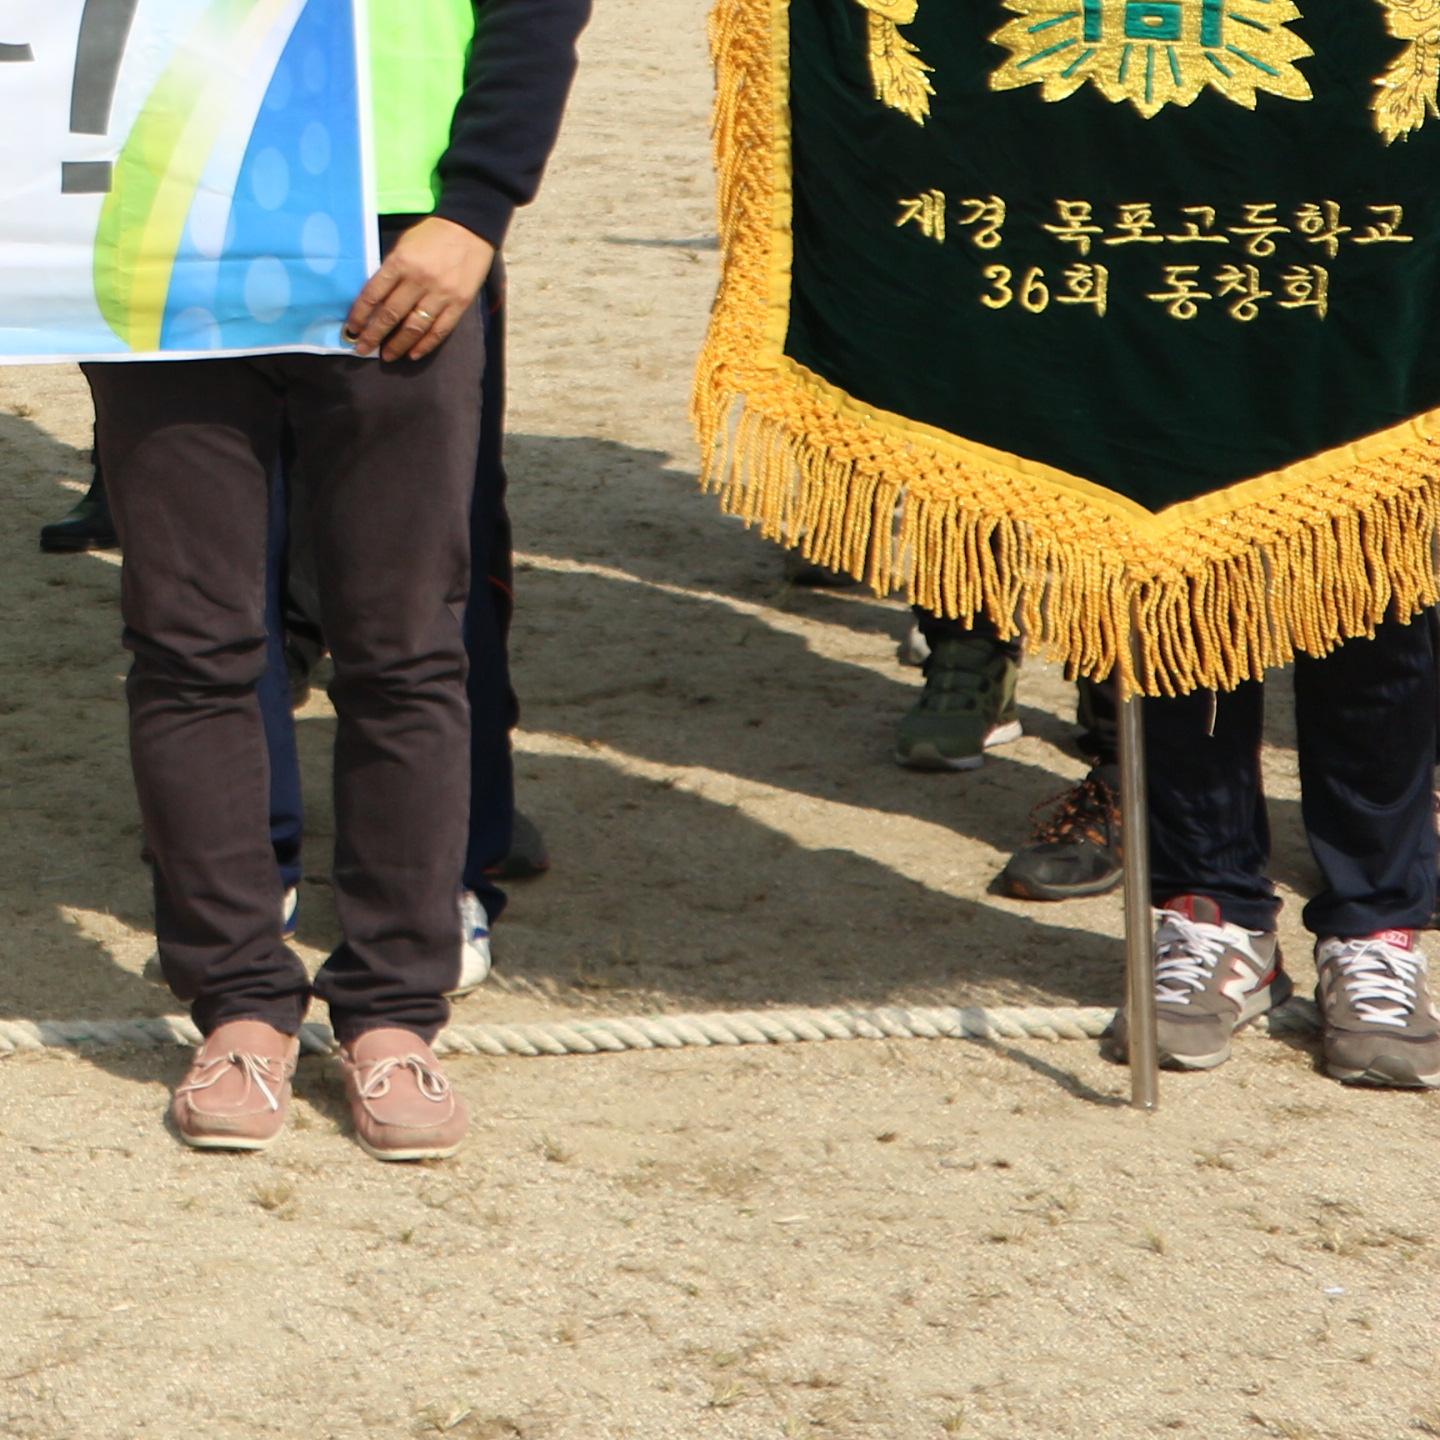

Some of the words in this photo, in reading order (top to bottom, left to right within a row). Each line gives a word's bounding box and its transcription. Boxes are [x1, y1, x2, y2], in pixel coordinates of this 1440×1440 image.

[896, 189, 1007, 250] 재경
[1041, 197, 1414, 260] 목포고등학교
[981, 262, 1110, 320] 36회
[1145, 262, 1331, 322] 동창회
